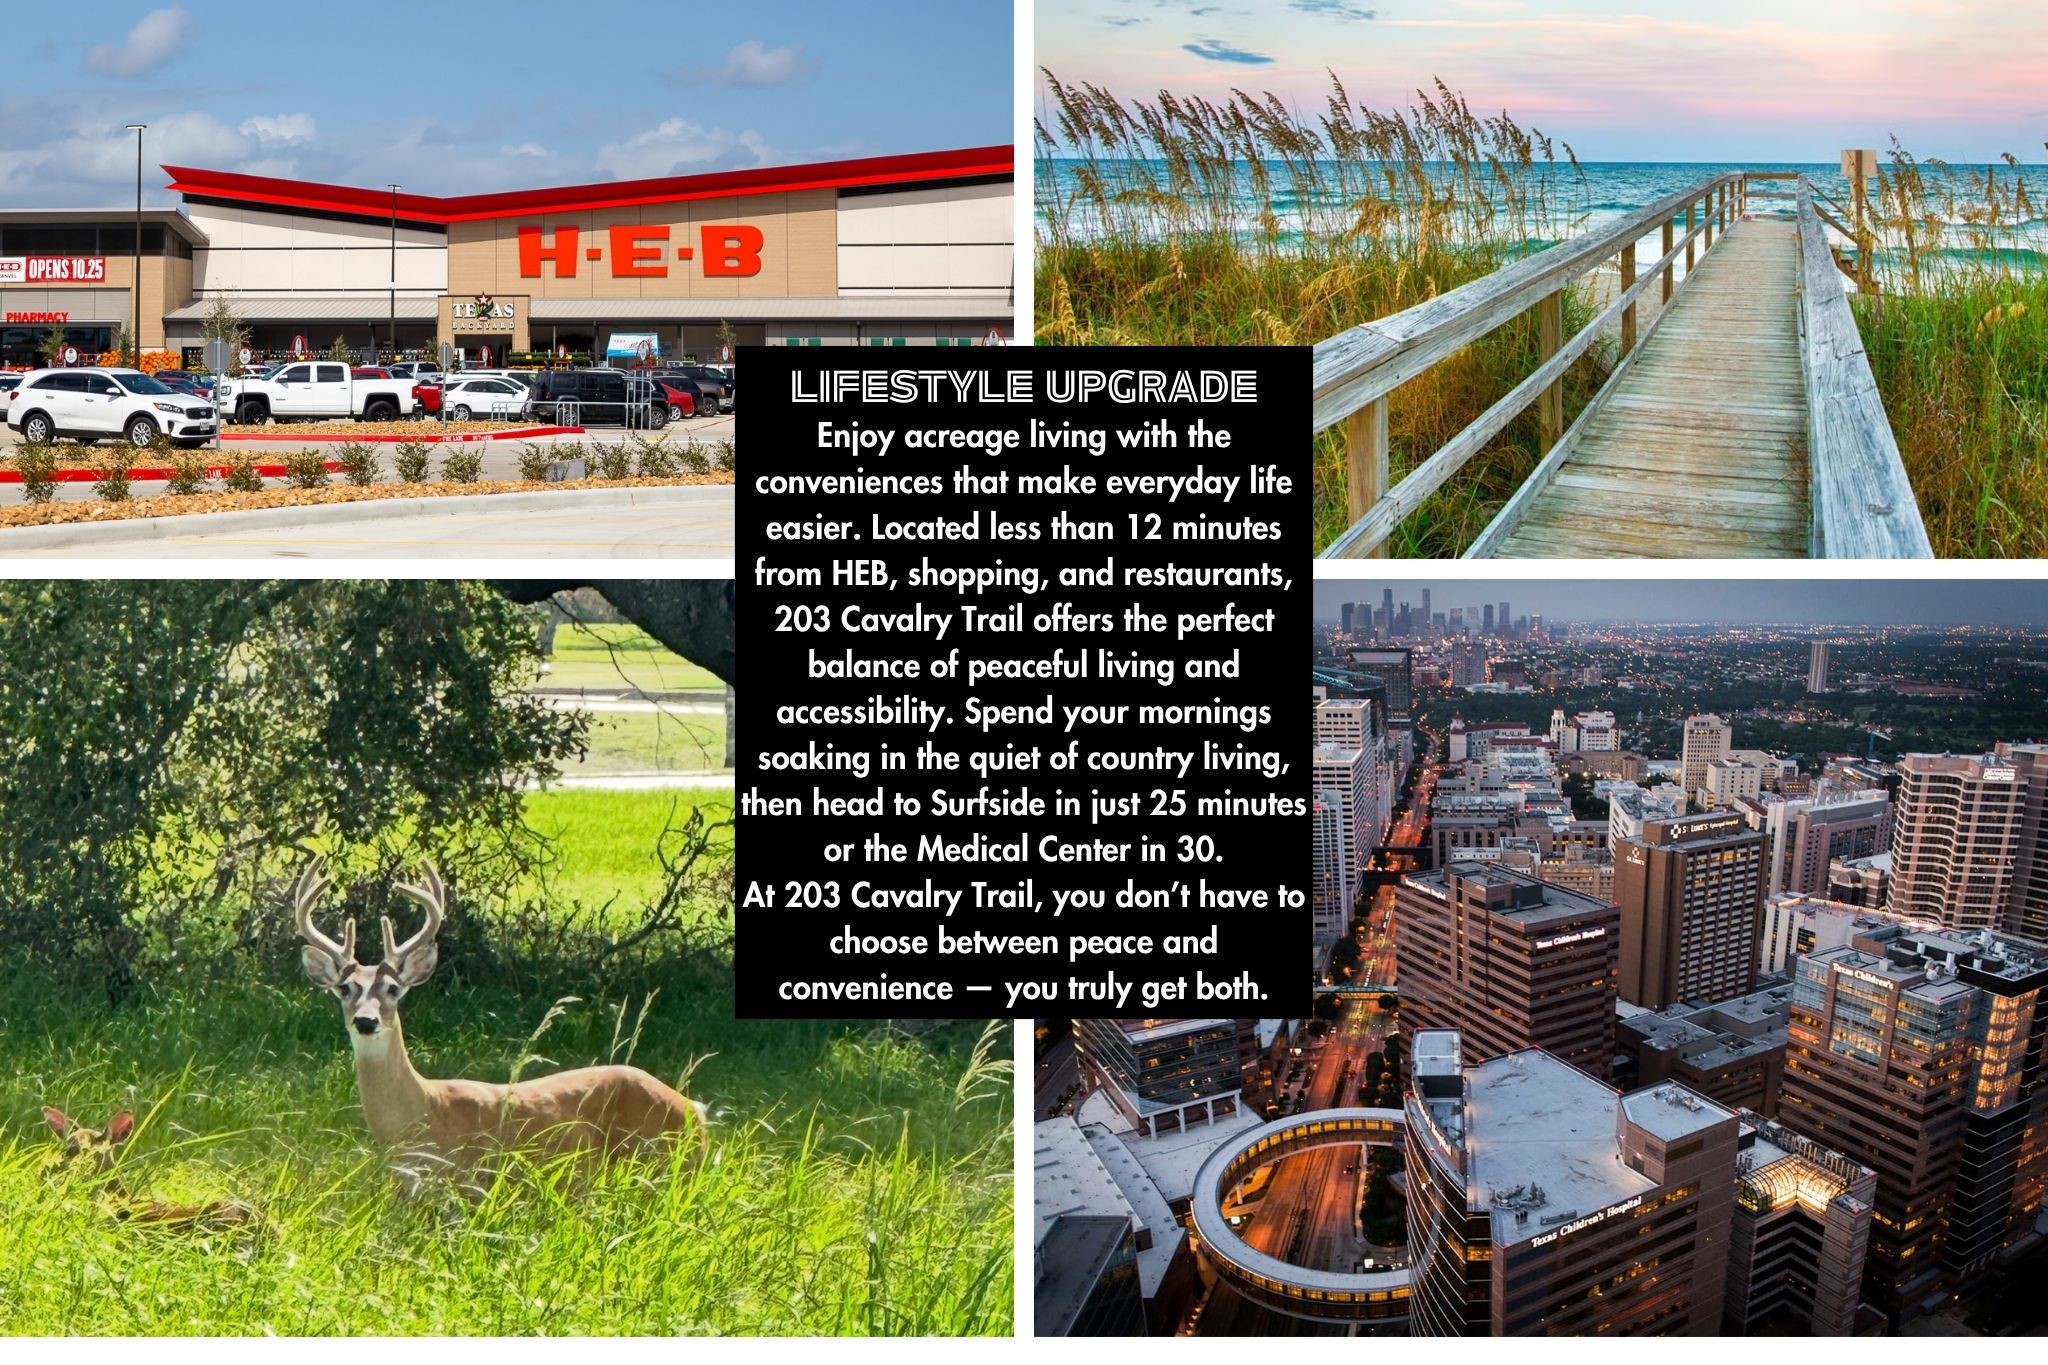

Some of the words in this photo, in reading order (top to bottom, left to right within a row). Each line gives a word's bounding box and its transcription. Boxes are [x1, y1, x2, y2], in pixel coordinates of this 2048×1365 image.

[29, 258, 69, 279] OPENS
[71, 258, 103, 279] 10.25
[6, 312, 69, 324] PHARMACY
[452, 321, 515, 330] BACKYARD
[1832, 962, 1854, 977] Texas
[1854, 970, 1894, 989] Children's
[1531, 1232, 1558, 1247] Texas
[1559, 1212, 1605, 1236] Children's
[1606, 1195, 1642, 1217] Hospital
